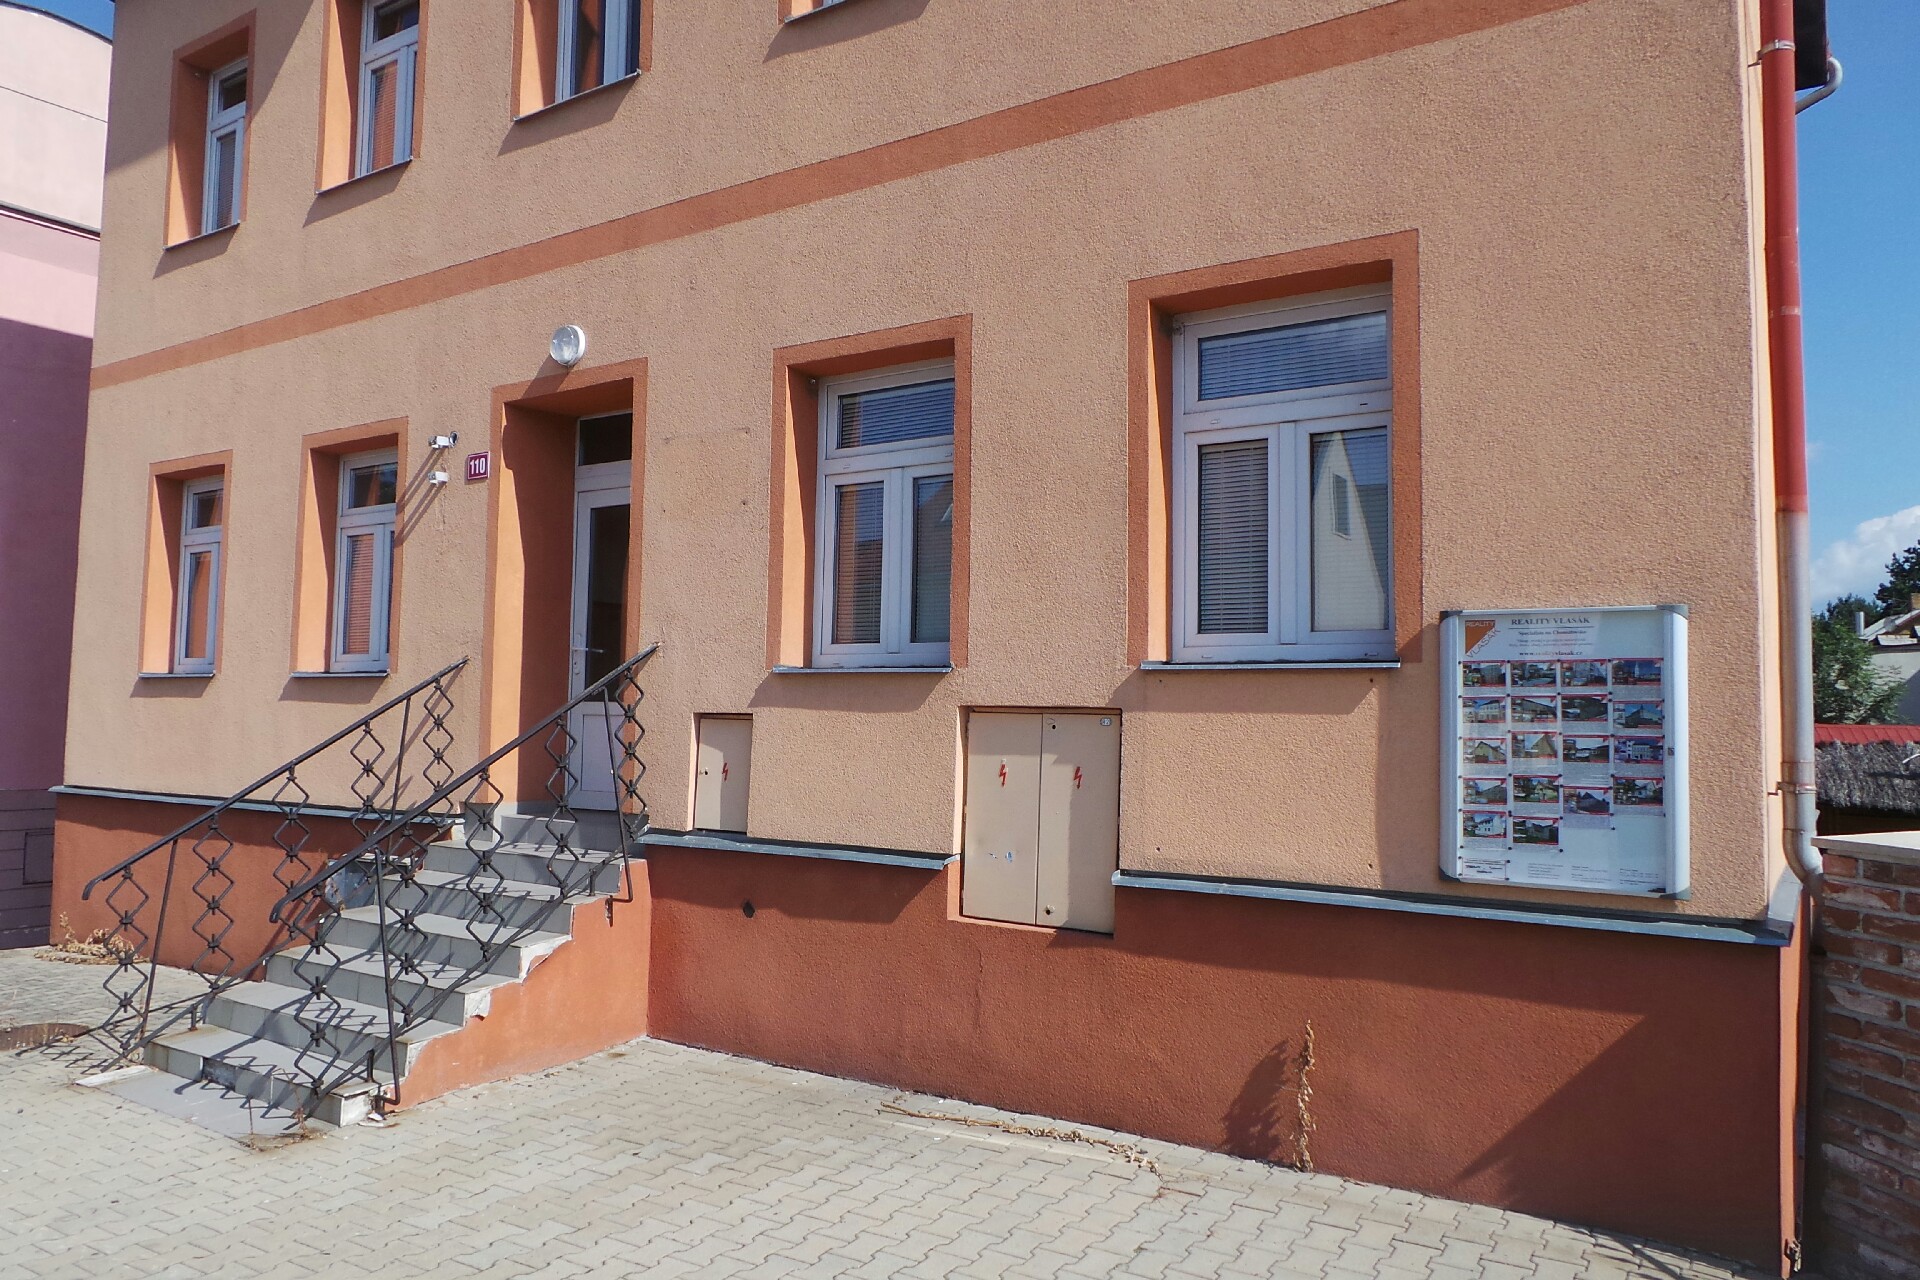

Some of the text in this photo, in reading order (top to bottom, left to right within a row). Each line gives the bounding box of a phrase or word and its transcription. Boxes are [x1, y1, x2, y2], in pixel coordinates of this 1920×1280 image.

[470, 458, 485, 474] 110
[1511, 615, 1590, 625] REALITY VLASÁK
[1466, 626, 1501, 658] VLASÁK
